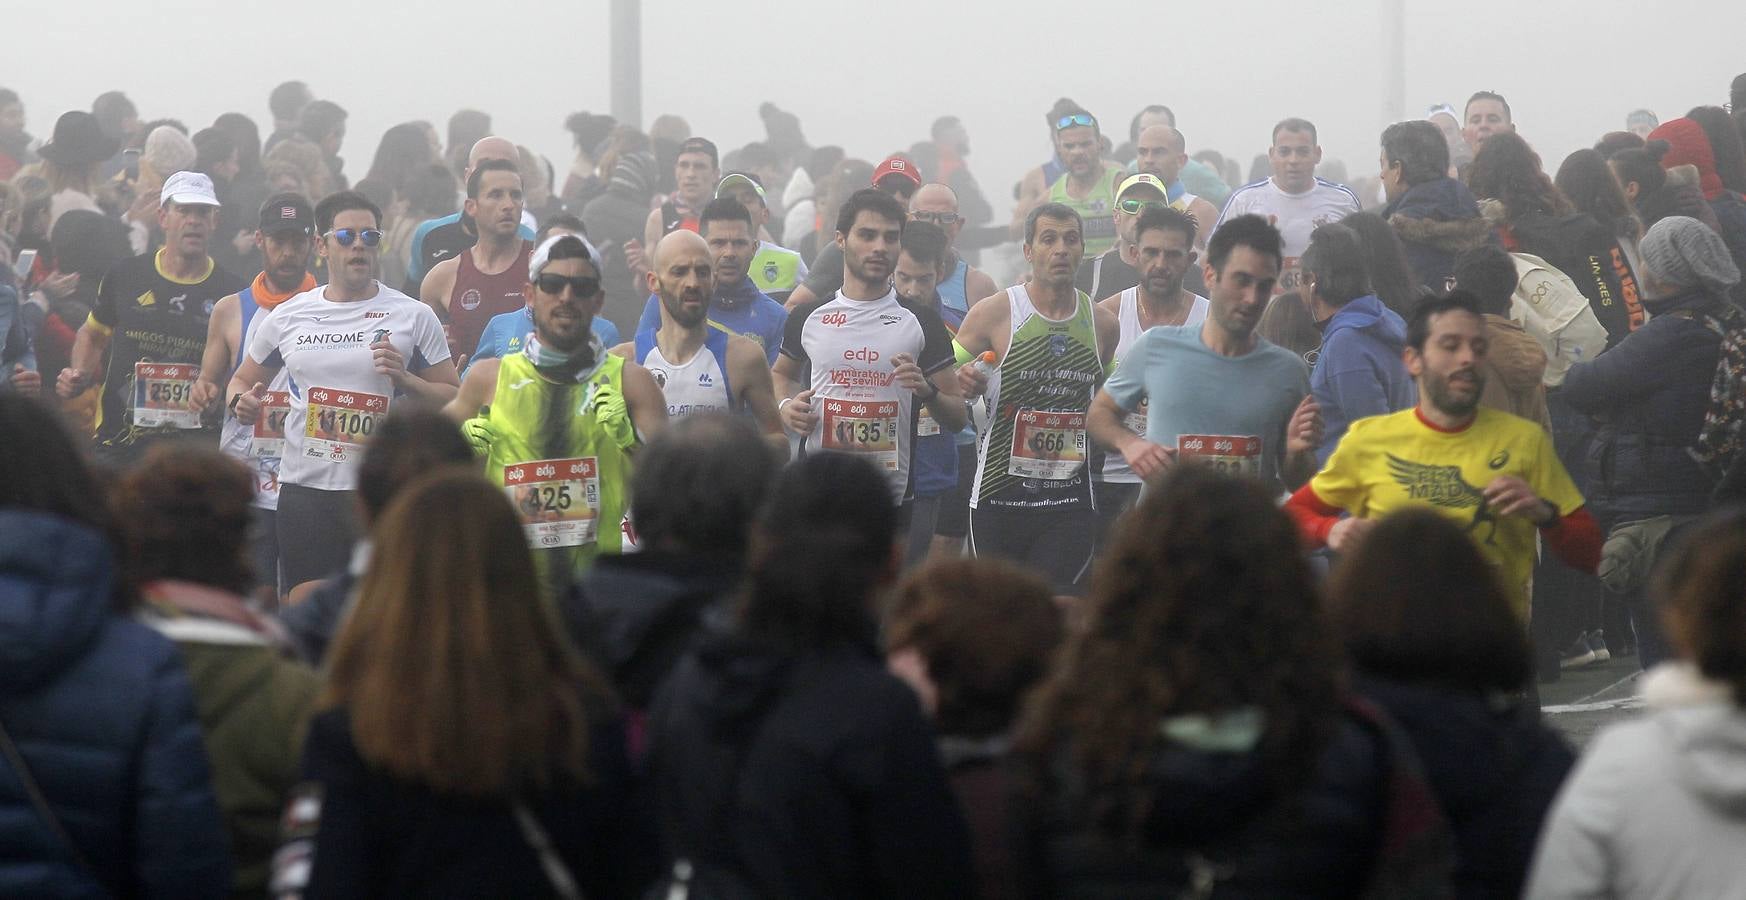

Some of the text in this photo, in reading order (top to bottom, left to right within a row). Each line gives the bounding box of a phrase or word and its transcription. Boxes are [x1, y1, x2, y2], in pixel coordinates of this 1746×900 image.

[1589, 255, 1612, 307] LINRES
[822, 311, 847, 327] edp
[296, 331, 364, 345] SANTOME
[844, 347, 879, 364] edp
[151, 384, 190, 402] 2591
[313, 390, 329, 402] edp
[337, 394, 354, 406] edp
[828, 402, 894, 415] edp edp edp
[1022, 412, 1037, 424] edp
[1046, 416, 1060, 427] edp
[1029, 431, 1065, 453] 666
[1184, 438, 1203, 452] edp
[1214, 440, 1232, 453] edp
[508, 461, 590, 481] edp edp edp
[527, 485, 572, 512] 425
[1409, 484, 1465, 499] MAD
